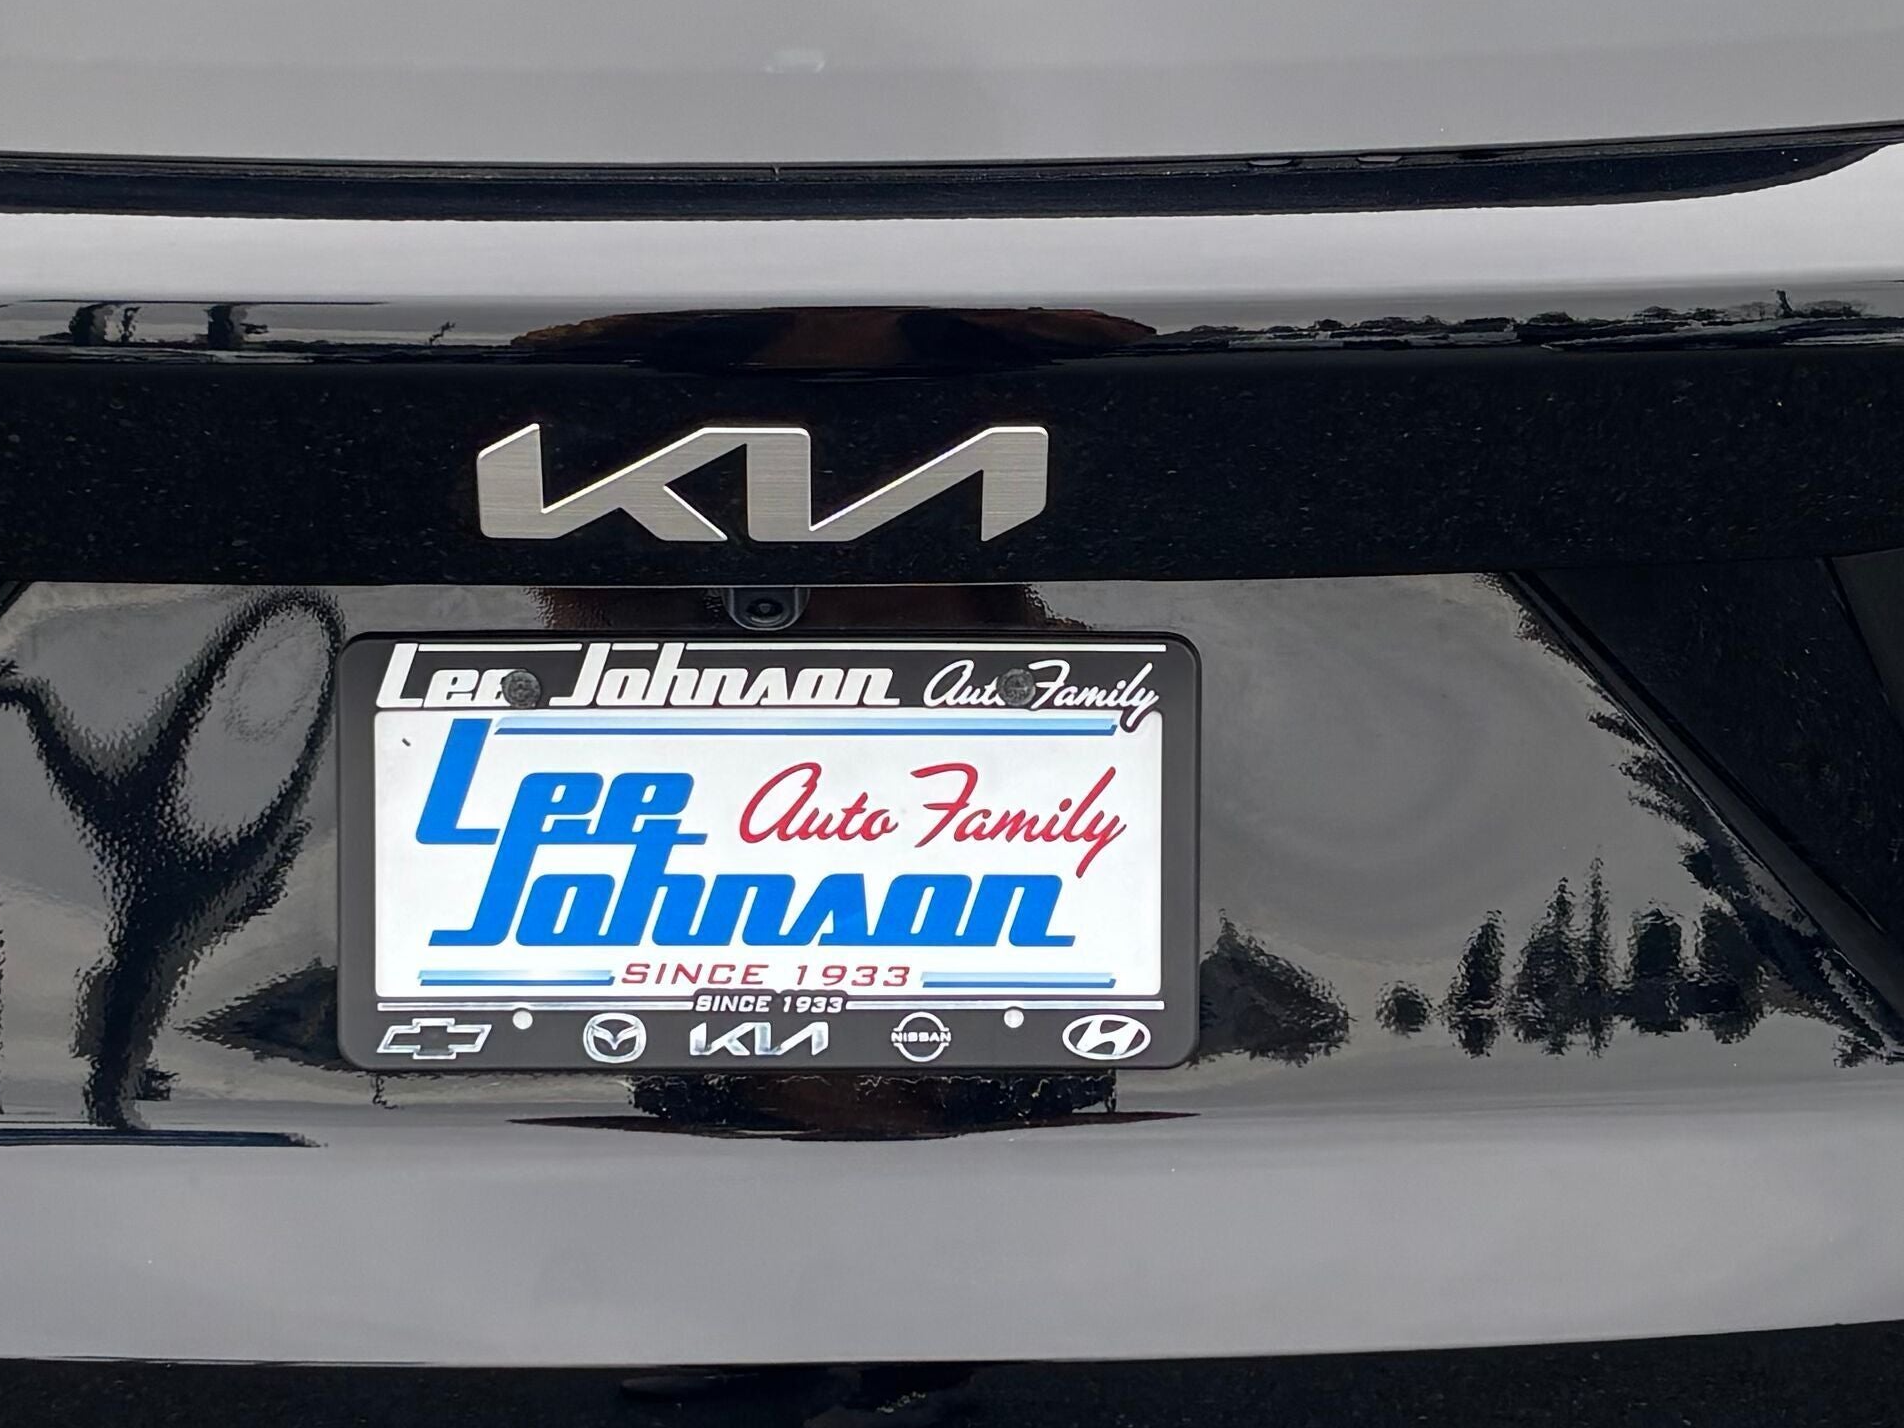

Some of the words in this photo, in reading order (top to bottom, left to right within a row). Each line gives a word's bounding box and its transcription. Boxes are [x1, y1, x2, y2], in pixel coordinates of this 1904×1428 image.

[477, 423, 1049, 542] KIA
[375, 643, 533, 708] Lee
[549, 643, 900, 707] Johnson
[922, 659, 1008, 708] Aut
[1027, 659, 1159, 728] Family
[415, 719, 707, 845] Lee
[738, 762, 900, 845] Auto
[910, 762, 1127, 878] Family
[428, 840, 1076, 947] Johnson
[621, 963, 770, 987] SINCE
[795, 963, 911, 988] 1933
[695, 995, 771, 1012] SINCE
[783, 995, 844, 1013] 1933
[891, 1031, 952, 1043] NISSAN
